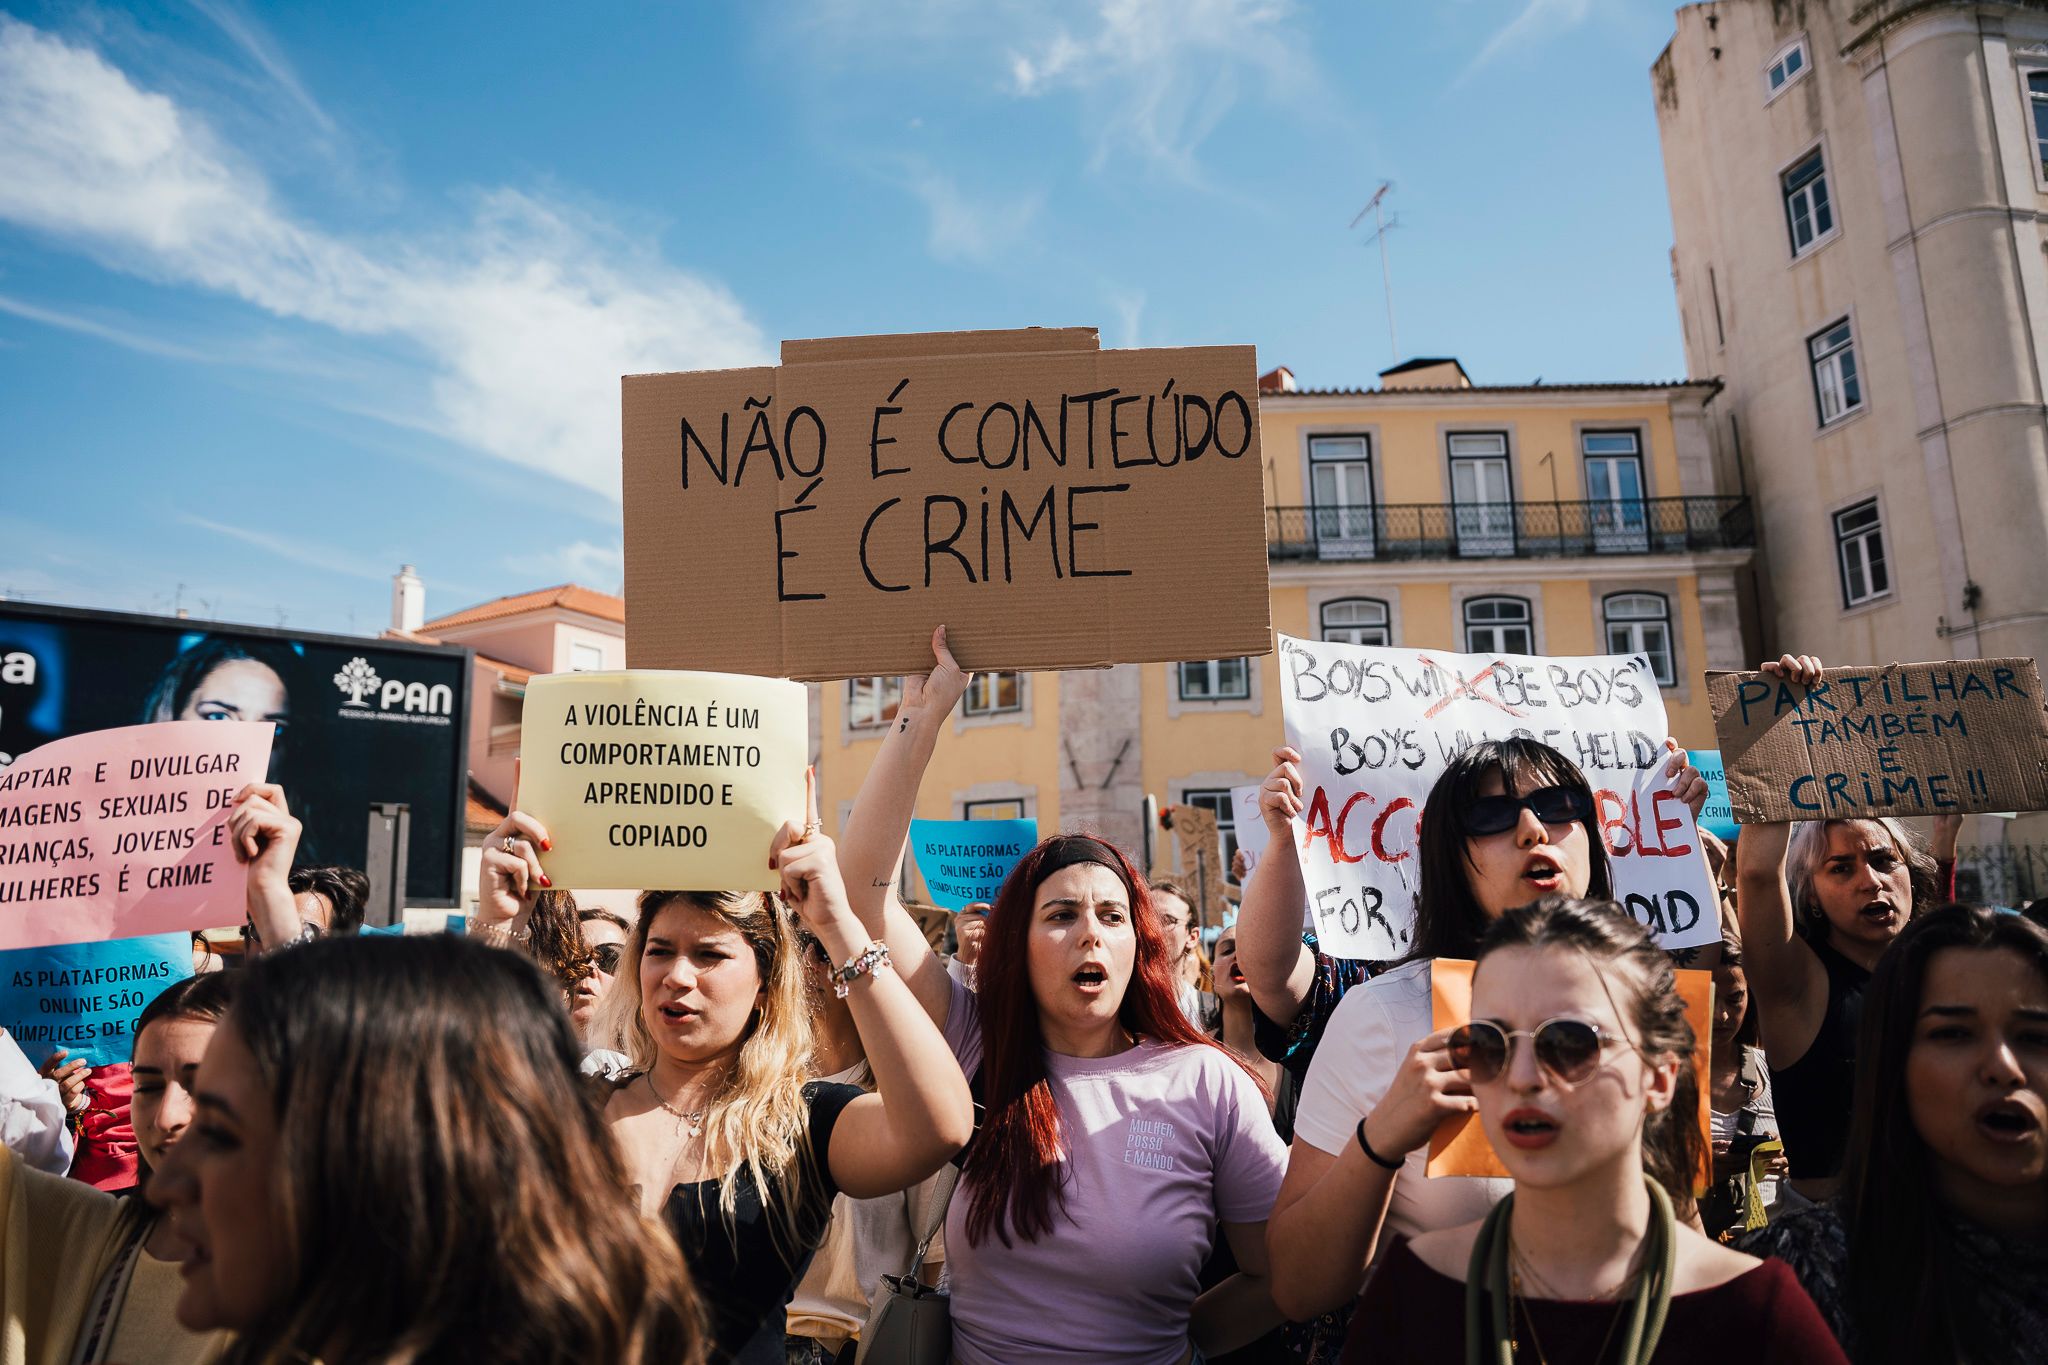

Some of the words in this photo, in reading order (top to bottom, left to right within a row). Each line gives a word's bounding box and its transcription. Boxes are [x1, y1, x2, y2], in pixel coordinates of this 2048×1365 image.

[681, 395, 826, 490] NÃO
[870, 378, 911, 481] É
[937, 378, 1252, 471] CONTEÚDO
[774, 477, 826, 602] É
[380, 679, 453, 714] PAN
[1493, 663, 1547, 707] BE
[564, 704, 577, 726] A
[585, 698, 698, 727] VIOLÊNCIA
[707, 700, 718, 727] É
[726, 707, 759, 729] UM
[1792, 705, 1968, 746] TAMBÉM
[560, 742, 761, 767] COMPORTAMENTO
[1330, 727, 1425, 776] BOYS
[1572, 730, 1658, 770] HELD
[1878, 740, 1904, 773] É
[0, 766, 72, 792] APTAR
[95, 762, 107, 783] E
[130, 753, 240, 780] DIVULGAR
[99, 791, 188, 819] SEXUAIS
[206, 788, 234, 810] DE
[584, 782, 714, 806] APRENDIDO
[722, 784, 733, 806] E
[1705, 806, 1731, 818] CRIM
[0, 837, 94, 868] RIANÇAS,
[112, 827, 195, 855] JOVENS
[212, 825, 225, 846] E
[609, 824, 708, 848] COPIADO
[926, 843, 936, 855] AS
[938, 843, 1020, 858] PLATAFORMAS
[0, 873, 100, 903] ULHERES
[118, 864, 130, 892] É
[147, 862, 214, 889] CRIME
[940, 864, 976, 879] ONLINE
[980, 863, 1003, 878] SÃO
[976, 886, 991, 899] DE
[13, 970, 33, 988] AS
[38, 961, 169, 988] PLATAFORMAS
[40, 995, 103, 1014] ONLINE
[108, 989, 144, 1010] SÃO
[102, 1020, 125, 1036] DE
[1127, 1134, 1163, 1151] POSSO
[1129, 1119, 1176, 1139] MULHER,
[1124, 1150, 1132, 1163] E
[1133, 1150, 1174, 1171] MANDO
